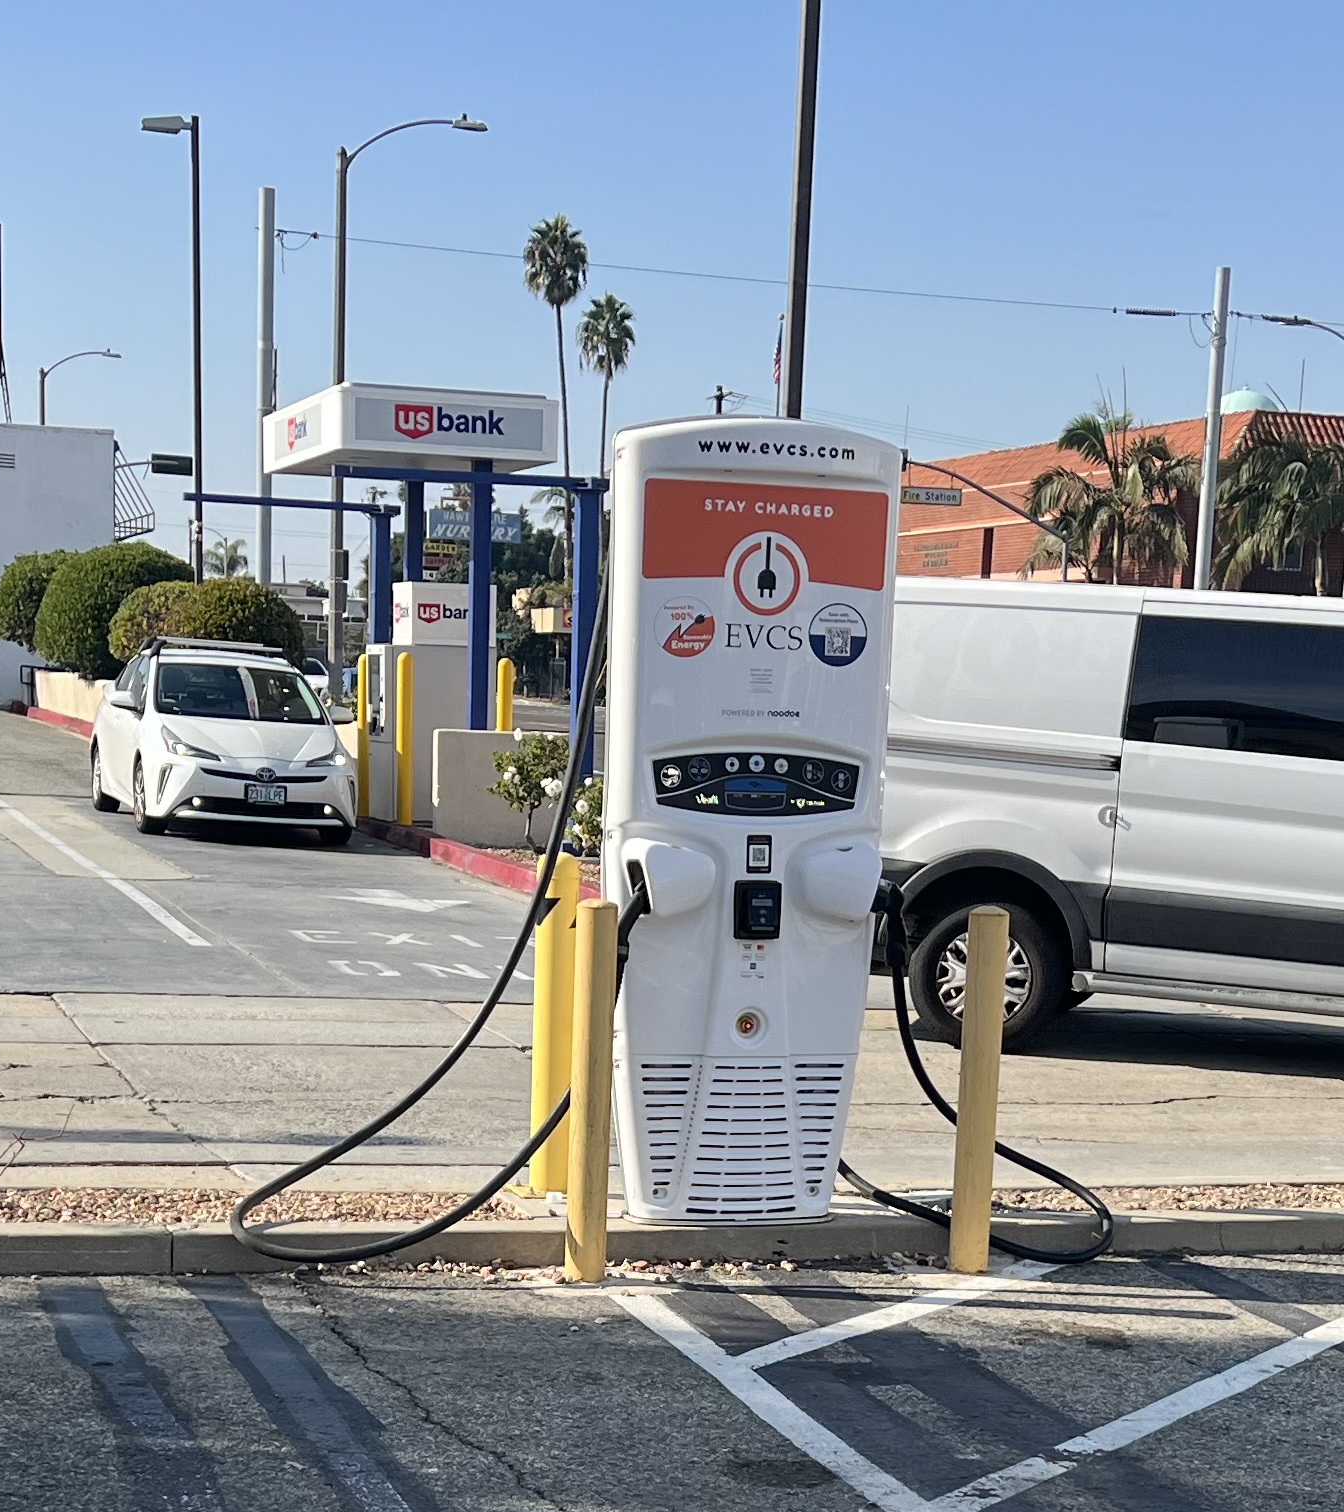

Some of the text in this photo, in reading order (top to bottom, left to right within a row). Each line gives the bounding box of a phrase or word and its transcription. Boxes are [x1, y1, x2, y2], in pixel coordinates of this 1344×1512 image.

[397, 406, 504, 435] us bank
[698, 440, 855, 460] www.evcs.com
[903, 490, 957, 502] Fire Station
[704, 499, 834, 518] STAY CHARGED
[420, 606, 439, 618] us
[671, 612, 695, 621] 100%
[725, 623, 803, 650] EVCS
[671, 639, 705, 651] Energy
[722, 708, 755, 717] POWERED
[757, 709, 765, 717] BY
